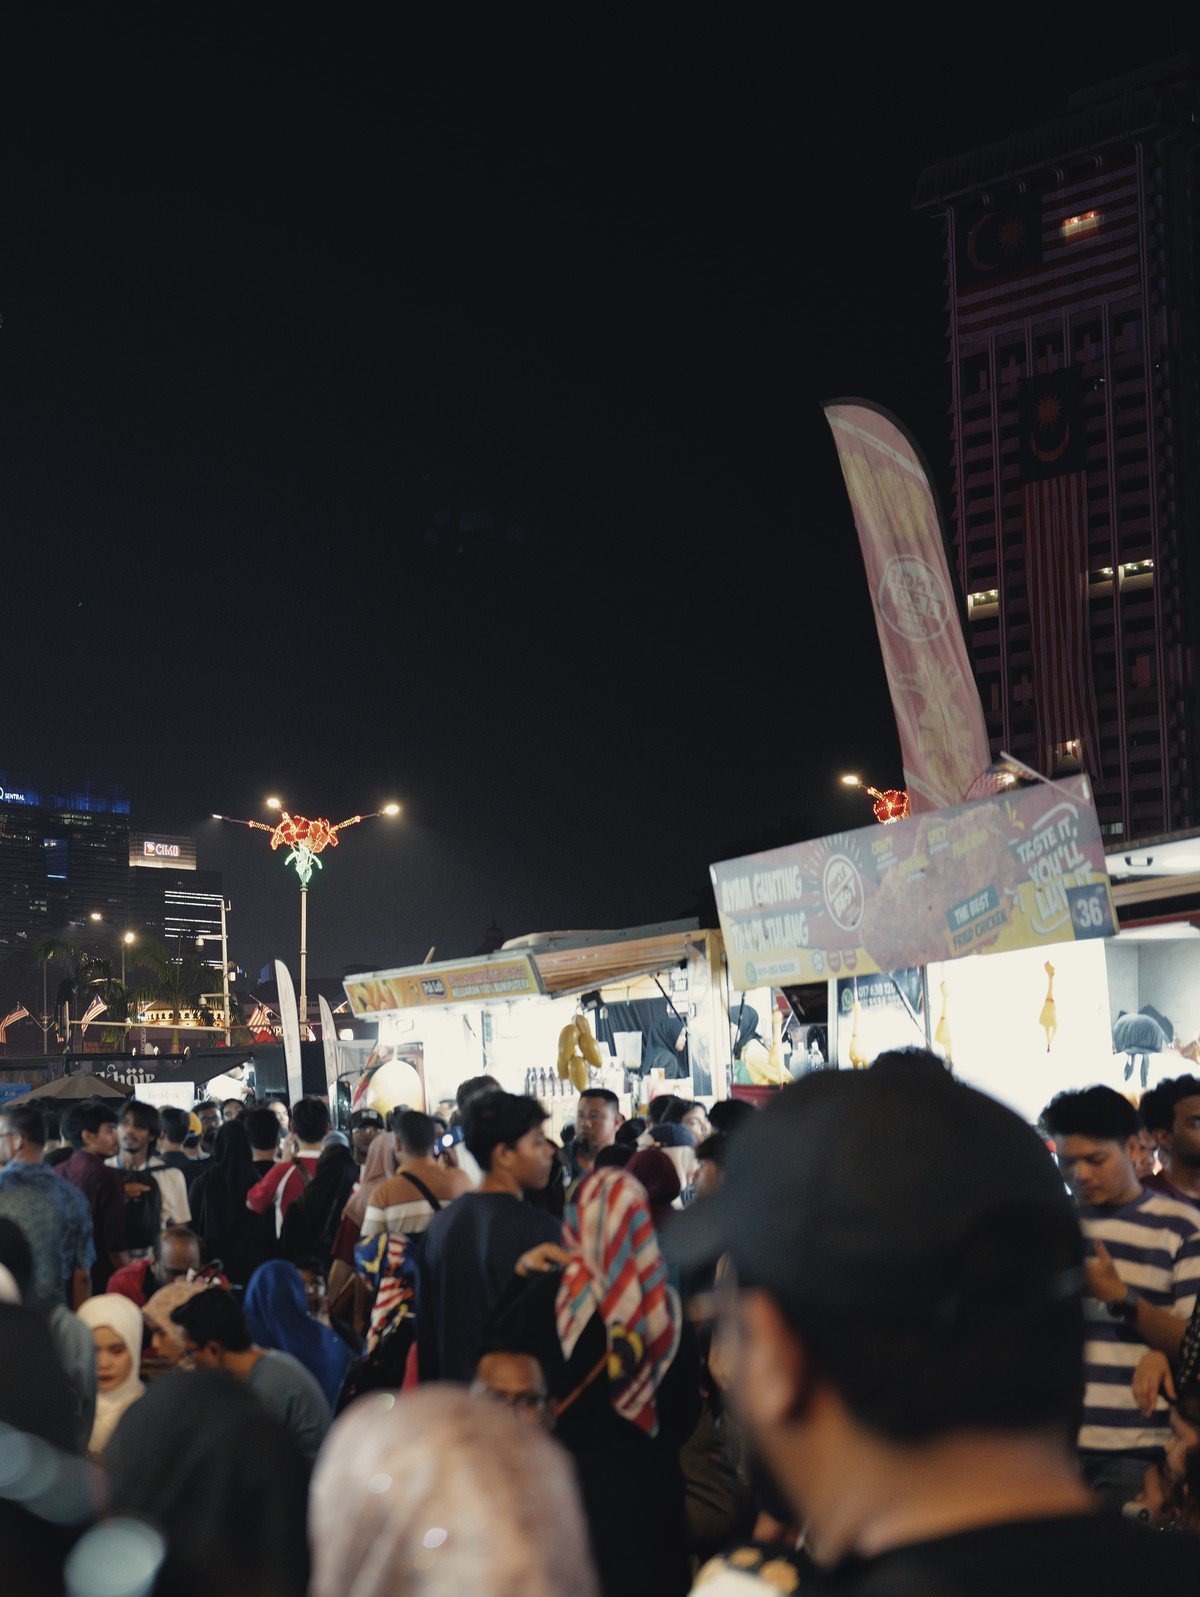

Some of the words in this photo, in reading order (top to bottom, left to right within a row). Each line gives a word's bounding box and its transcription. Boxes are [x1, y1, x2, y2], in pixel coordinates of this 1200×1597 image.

[4, 792, 25, 801] SENTRAL
[155, 844, 180, 857] CIMB
[1016, 826, 1058, 863] TASTE
[1028, 840, 1085, 888] YOU'LL
[753, 865, 803, 906] GUNTING
[975, 909, 1007, 938] CHICKEN
[1077, 896, 1103, 928] 36
